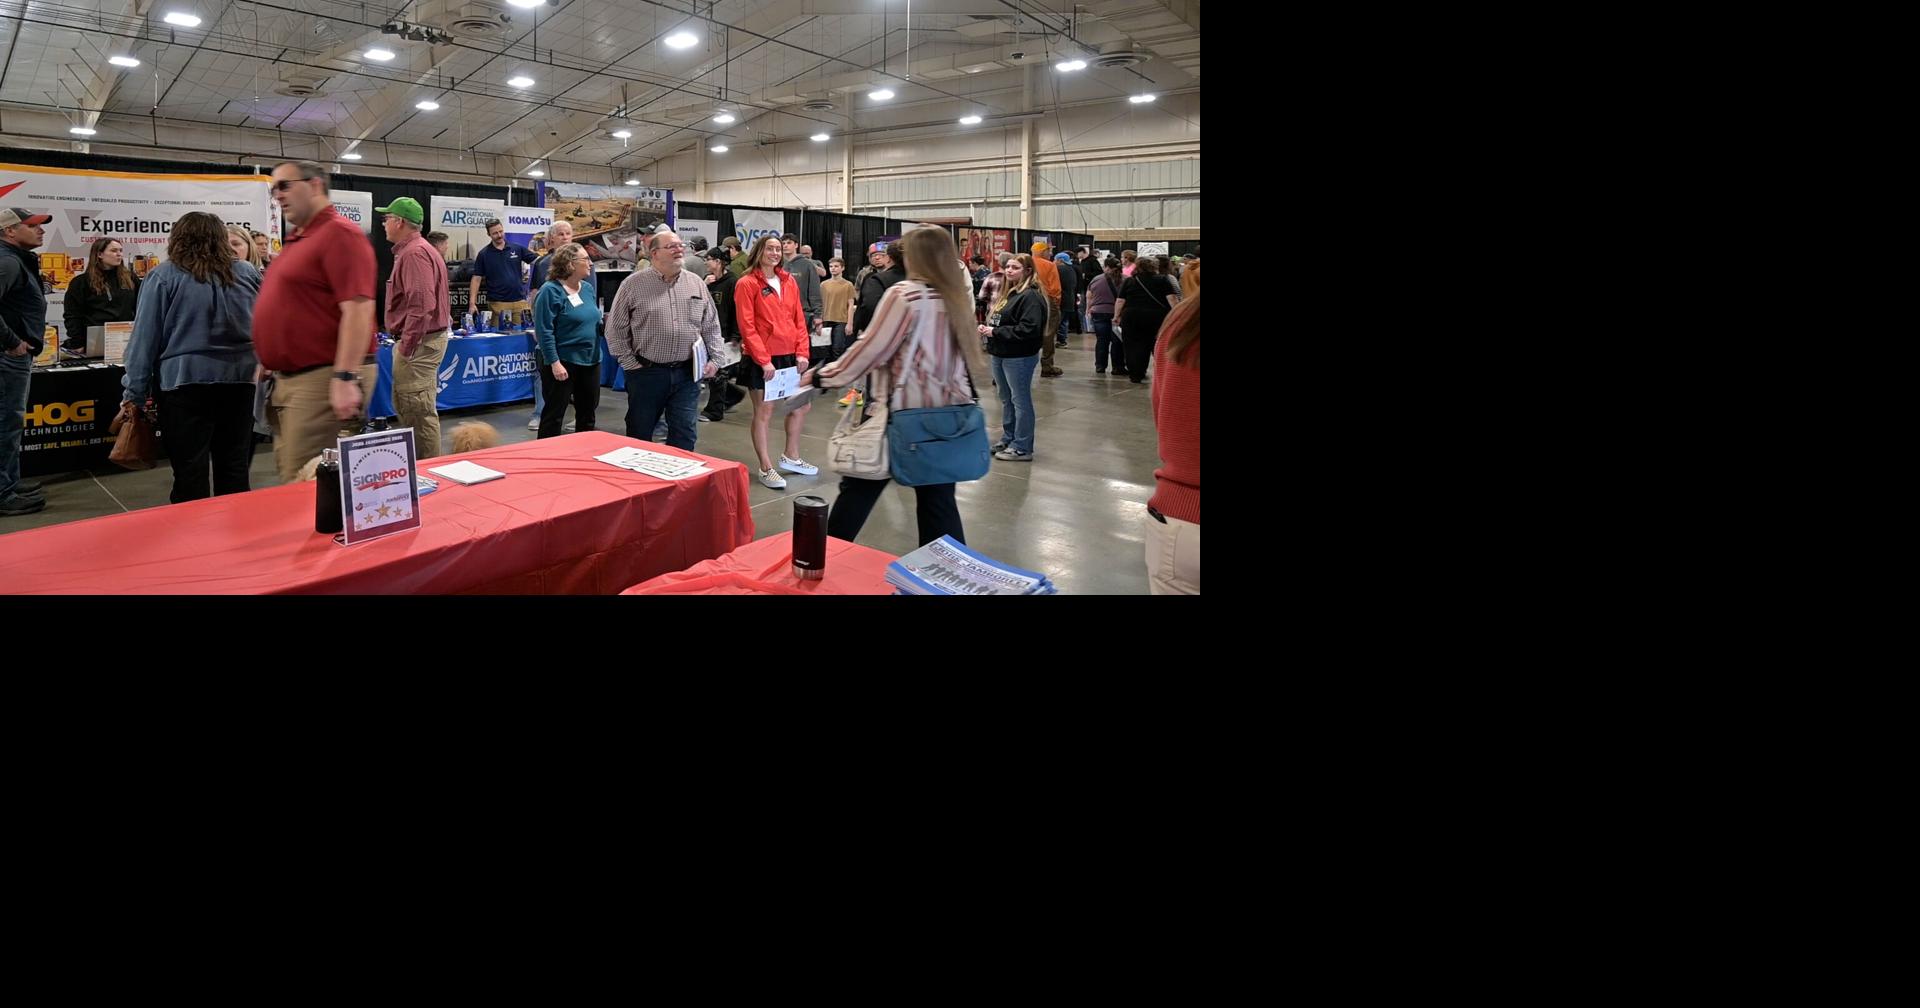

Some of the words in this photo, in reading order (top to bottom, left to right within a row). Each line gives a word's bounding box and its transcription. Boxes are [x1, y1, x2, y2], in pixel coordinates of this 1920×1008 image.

[80, 215, 176, 235] Experienc
[441, 210, 466, 225] AIR
[508, 215, 552, 226] KOMATSU
[498, 352, 536, 363] NATIONAL
[462, 355, 498, 379] AIR
[498, 360, 537, 375] GUARD
[24, 423, 95, 437] ECHNOLOGIES
[352, 467, 408, 487] SIGNPRO
